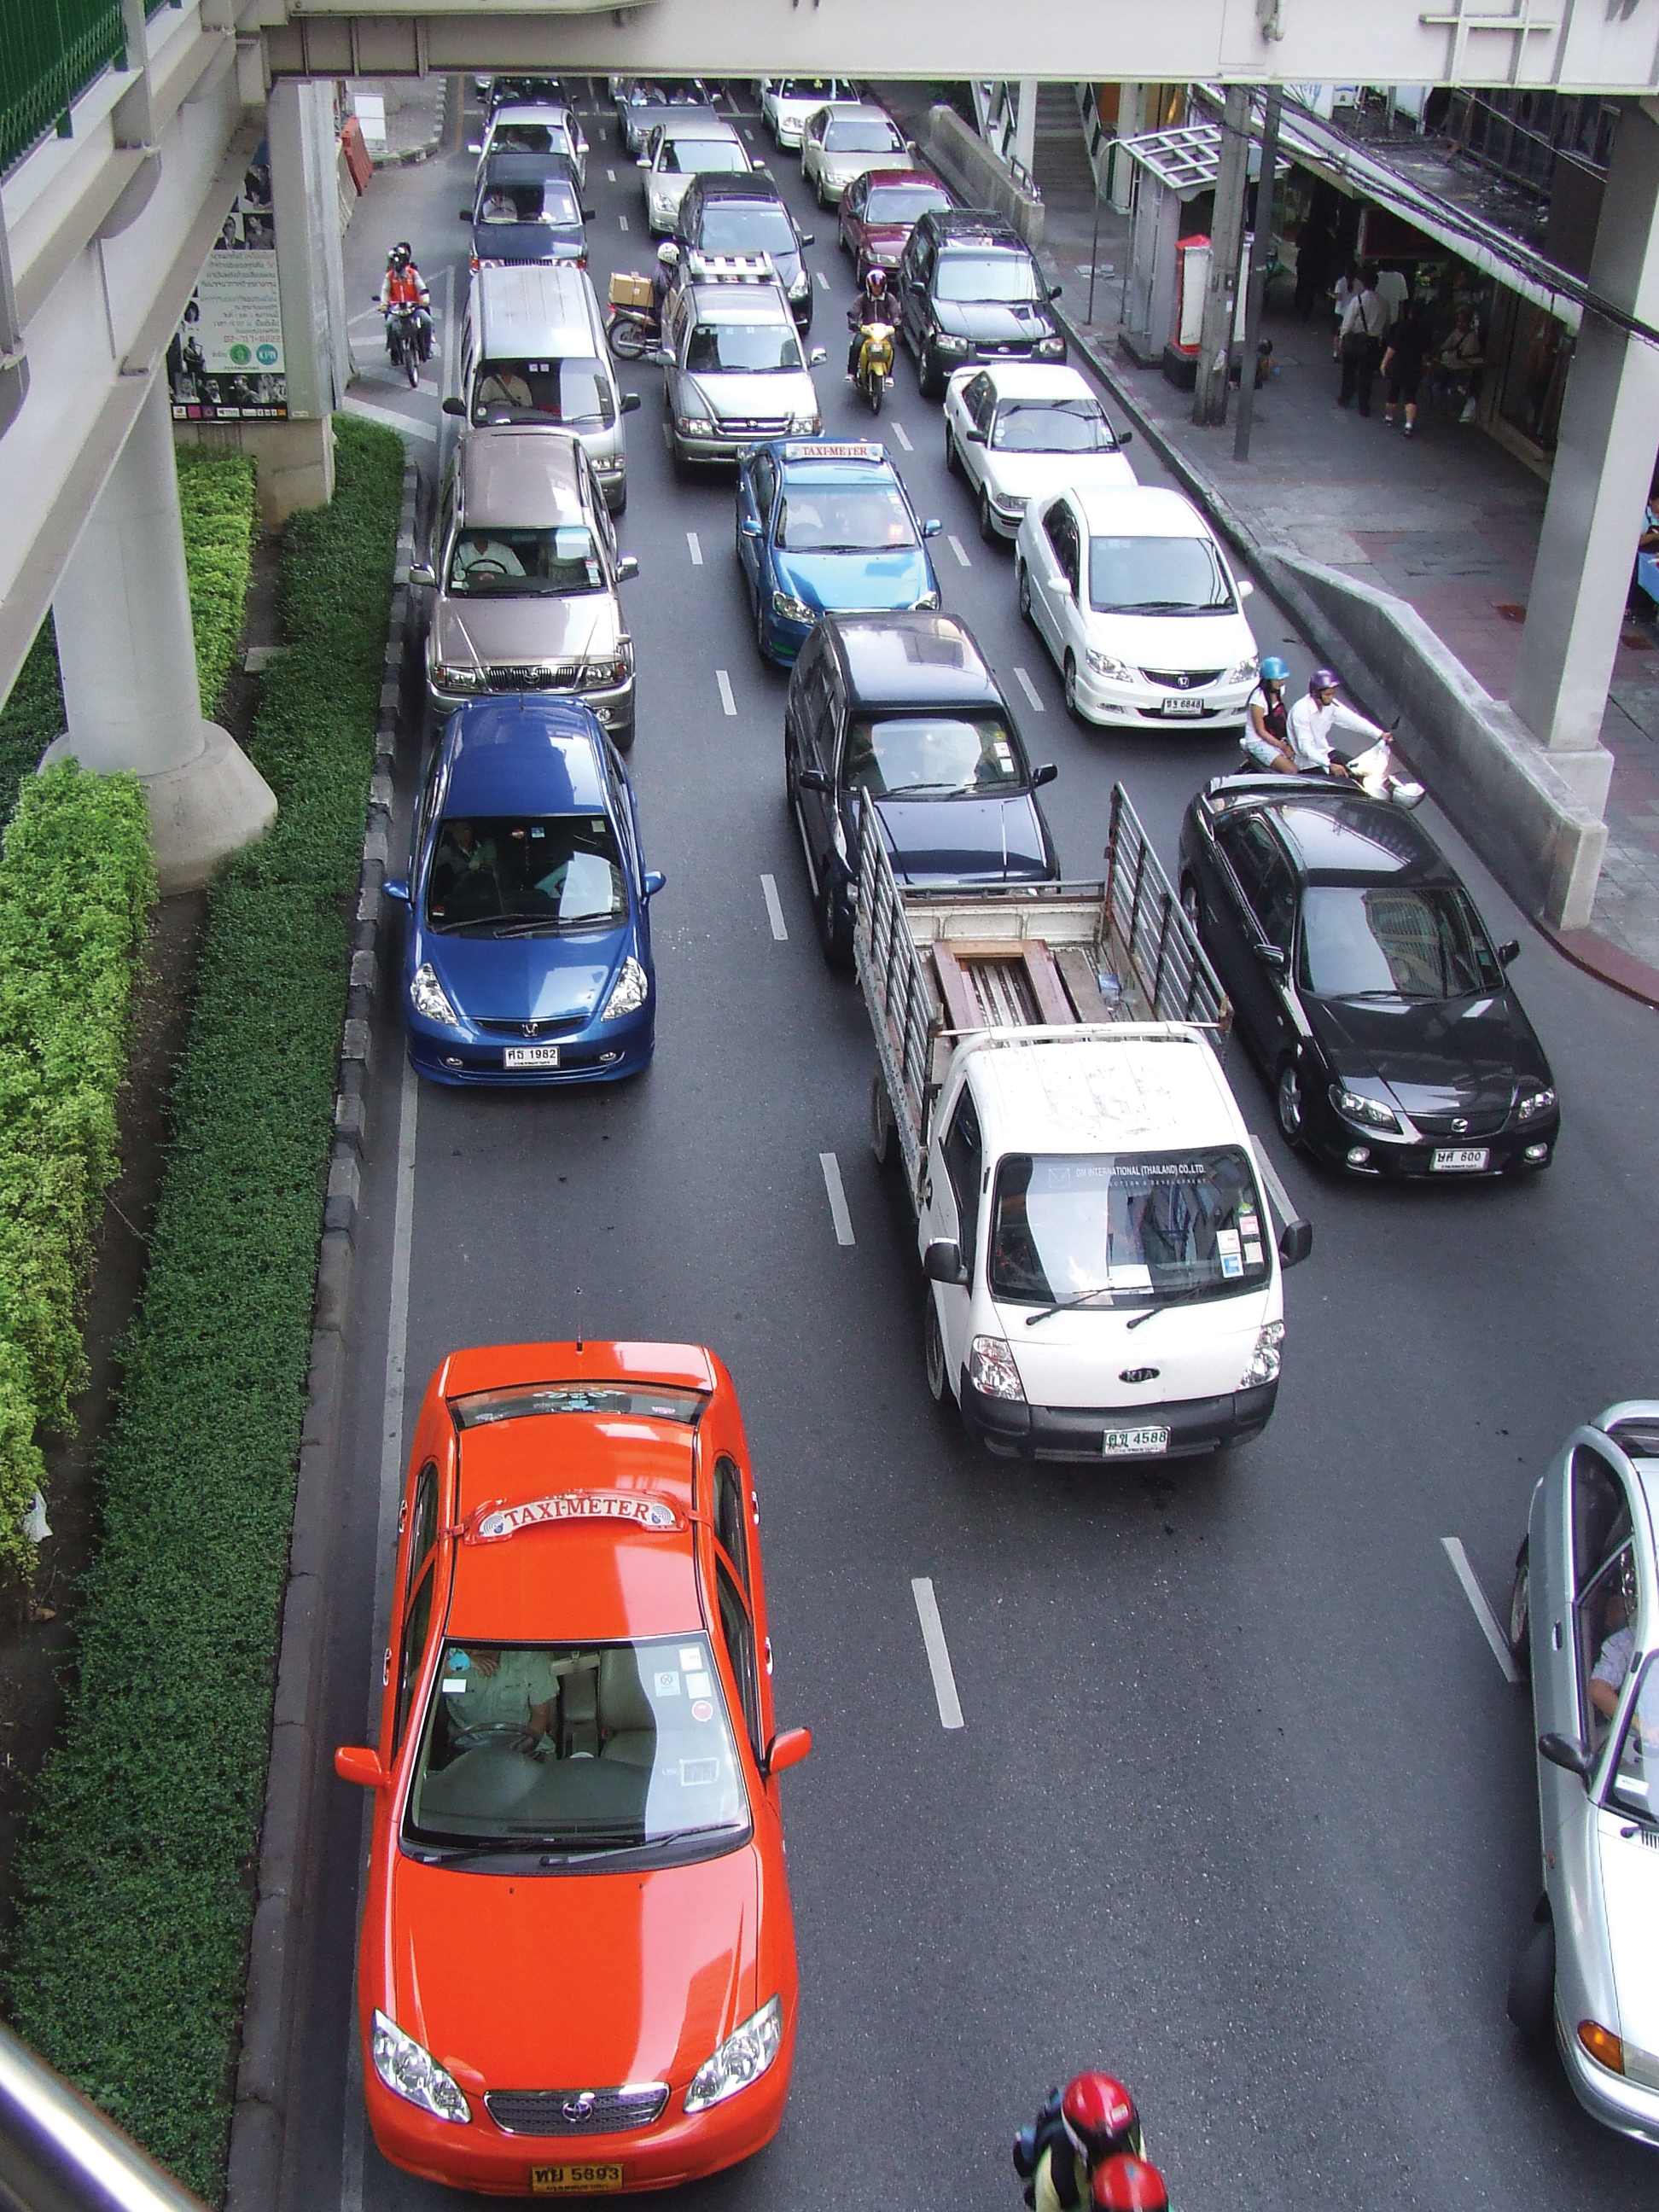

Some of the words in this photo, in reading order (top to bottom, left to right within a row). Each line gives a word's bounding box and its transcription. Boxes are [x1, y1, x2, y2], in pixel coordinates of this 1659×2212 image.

[802, 446, 867, 456] TAXI-METER
[530, 1049, 556, 1059] 1982
[1460, 1152, 1481, 1161] 600
[1087, 1166, 1140, 1176] INTERNATIONAL
[1141, 1164, 1178, 1177] (THAILAND)
[1126, 1370, 1154, 1382] KIA
[1133, 1431, 1167, 1444] 4588
[504, 1499, 650, 1527] TAXI-METER
